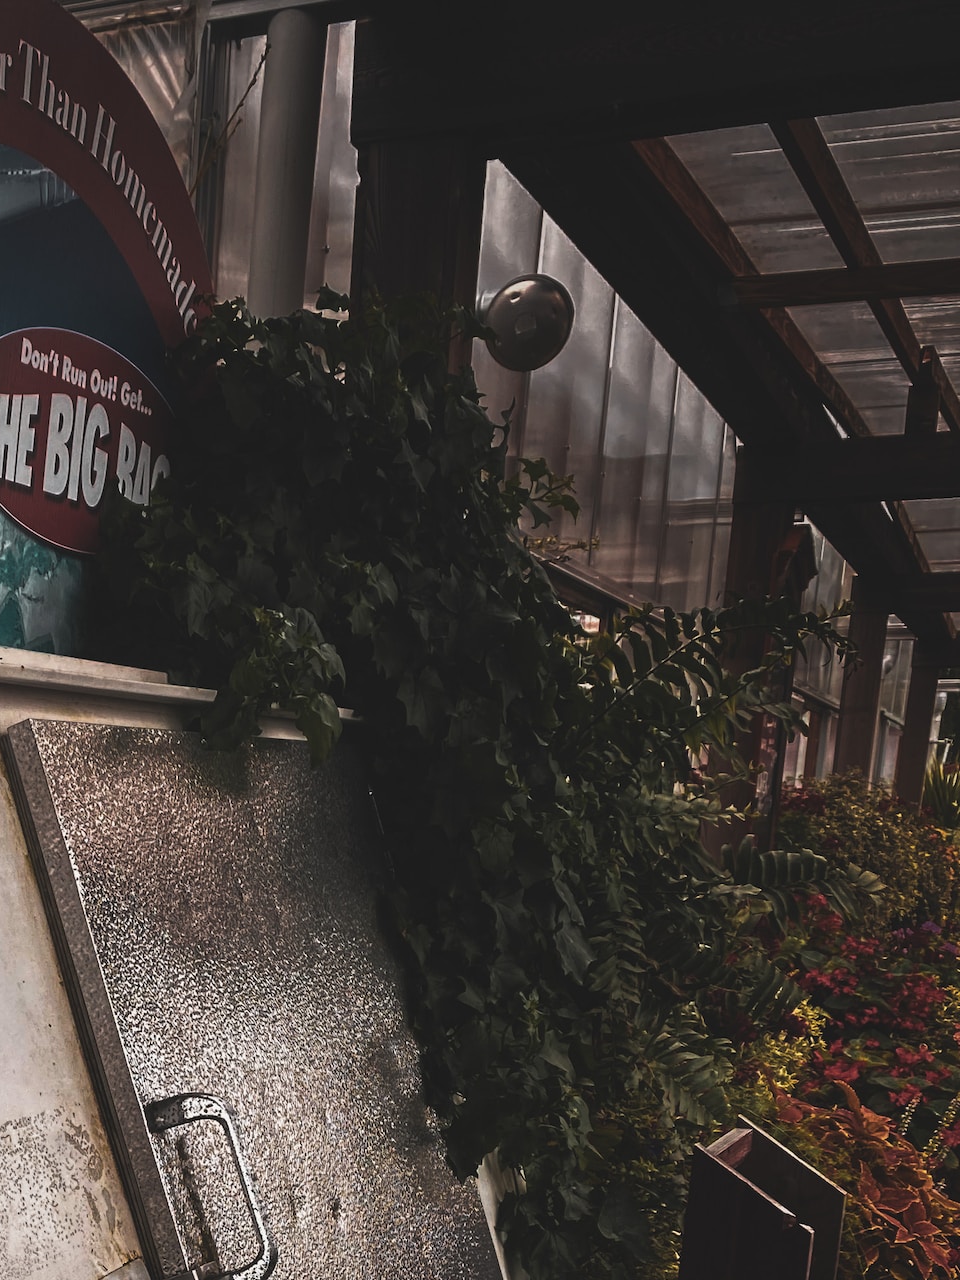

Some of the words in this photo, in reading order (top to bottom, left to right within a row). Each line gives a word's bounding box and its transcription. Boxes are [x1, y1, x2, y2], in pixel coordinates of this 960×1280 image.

[18, 39, 88, 145] Than
[90, 102, 198, 338] Homemade
[20, 337, 60, 377] Don't
[61, 355, 88, 389] Run
[90, 368, 119, 401] Out!
[120, 382, 153, 416] Get...
[42, 392, 111, 508] BIG
